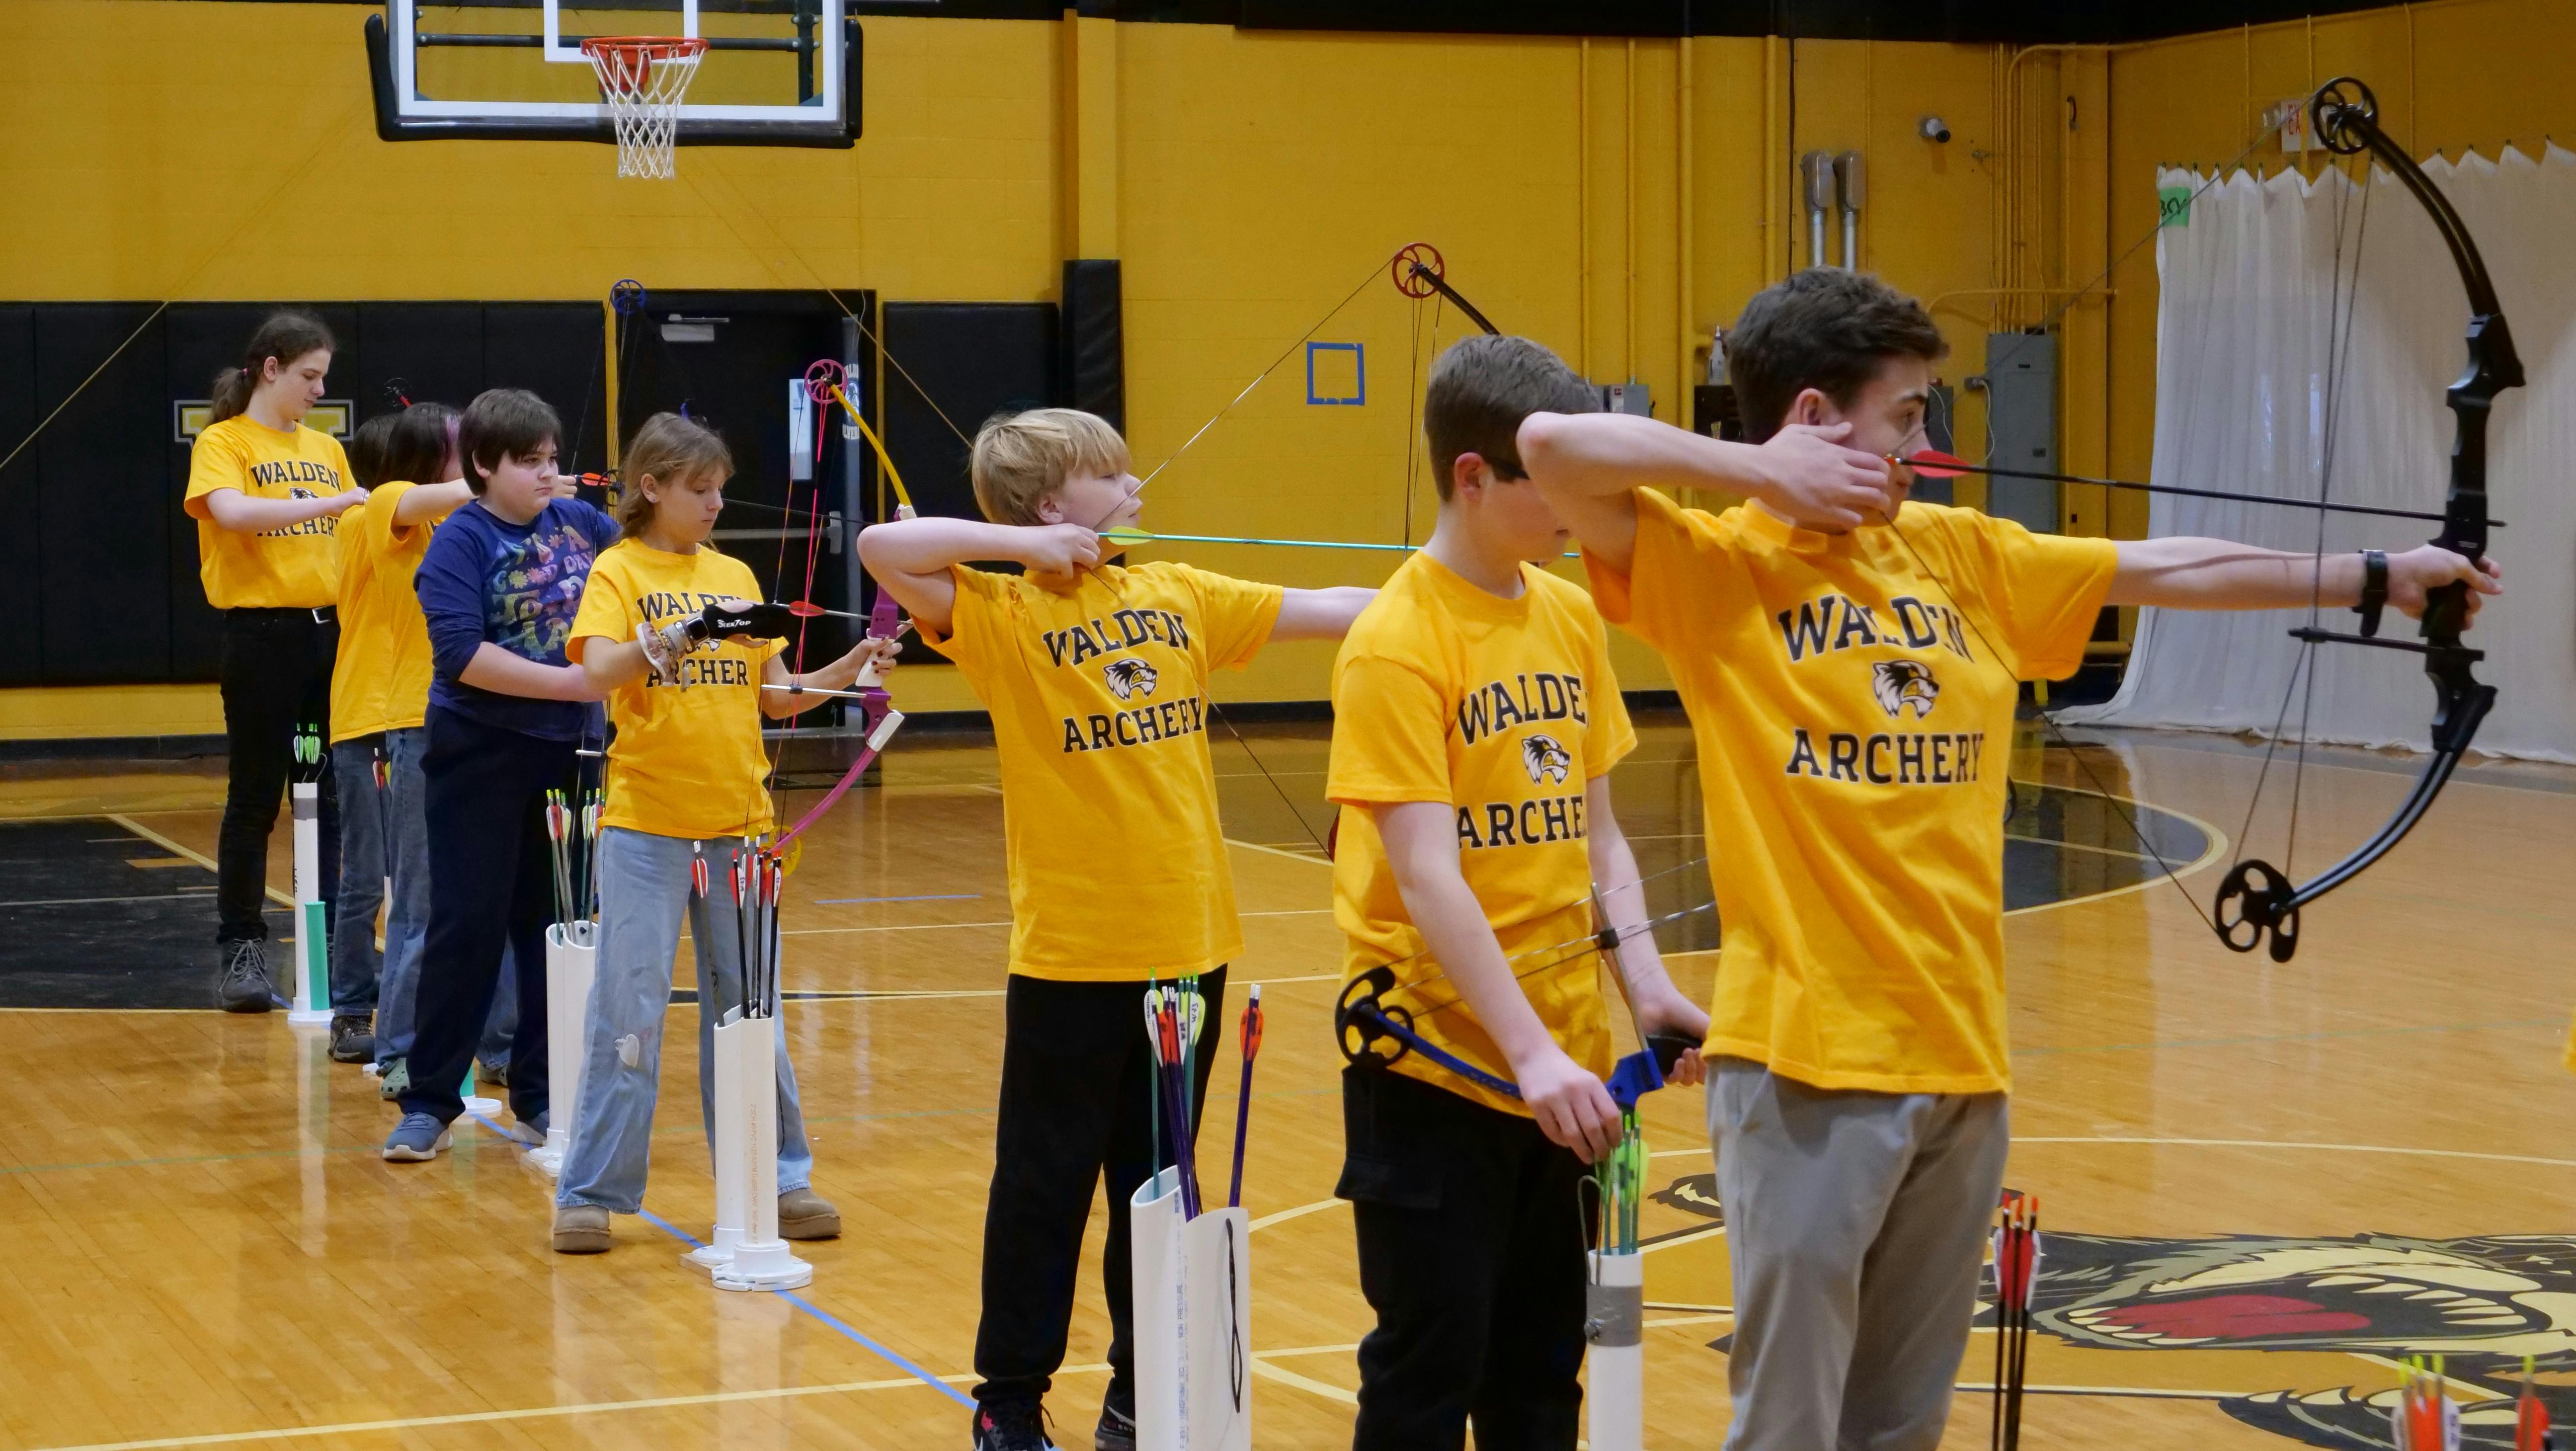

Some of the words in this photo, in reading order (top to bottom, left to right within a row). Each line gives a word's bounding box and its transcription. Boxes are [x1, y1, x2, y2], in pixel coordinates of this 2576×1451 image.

[250, 460, 341, 492] WALDEN
[1063, 696, 1203, 753] ARCHERY
[1458, 673, 1590, 745] WALDE
[1785, 728, 1984, 785] ARCHERY
[1457, 796, 1587, 849] ARCHE
